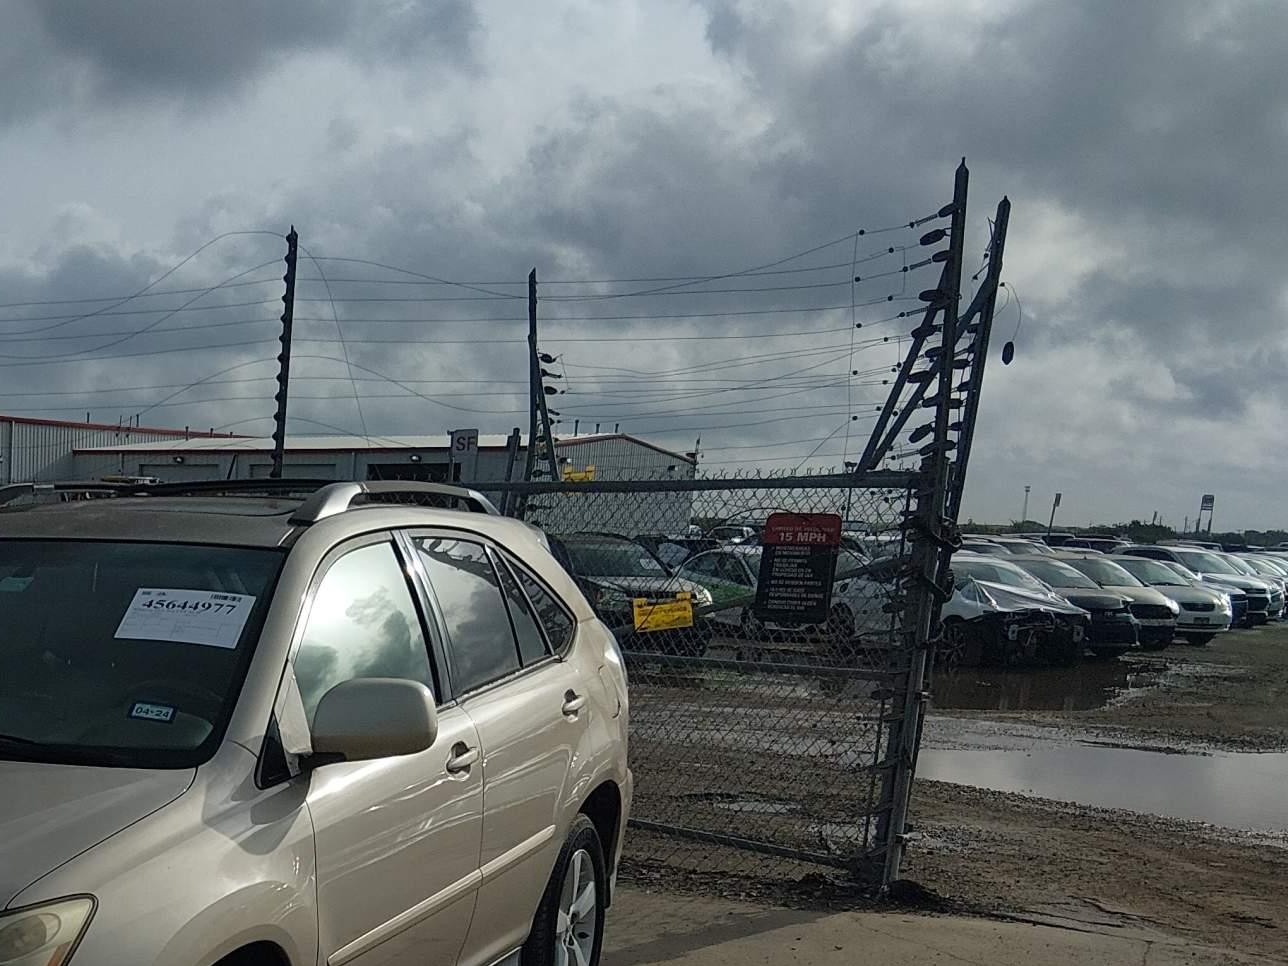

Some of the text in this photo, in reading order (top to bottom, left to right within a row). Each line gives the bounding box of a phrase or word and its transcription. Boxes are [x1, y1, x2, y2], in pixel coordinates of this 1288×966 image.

[456, 436, 476, 451] SF
[779, 532, 827, 543] 15 MPH
[141, 599, 236, 615] 45644977
